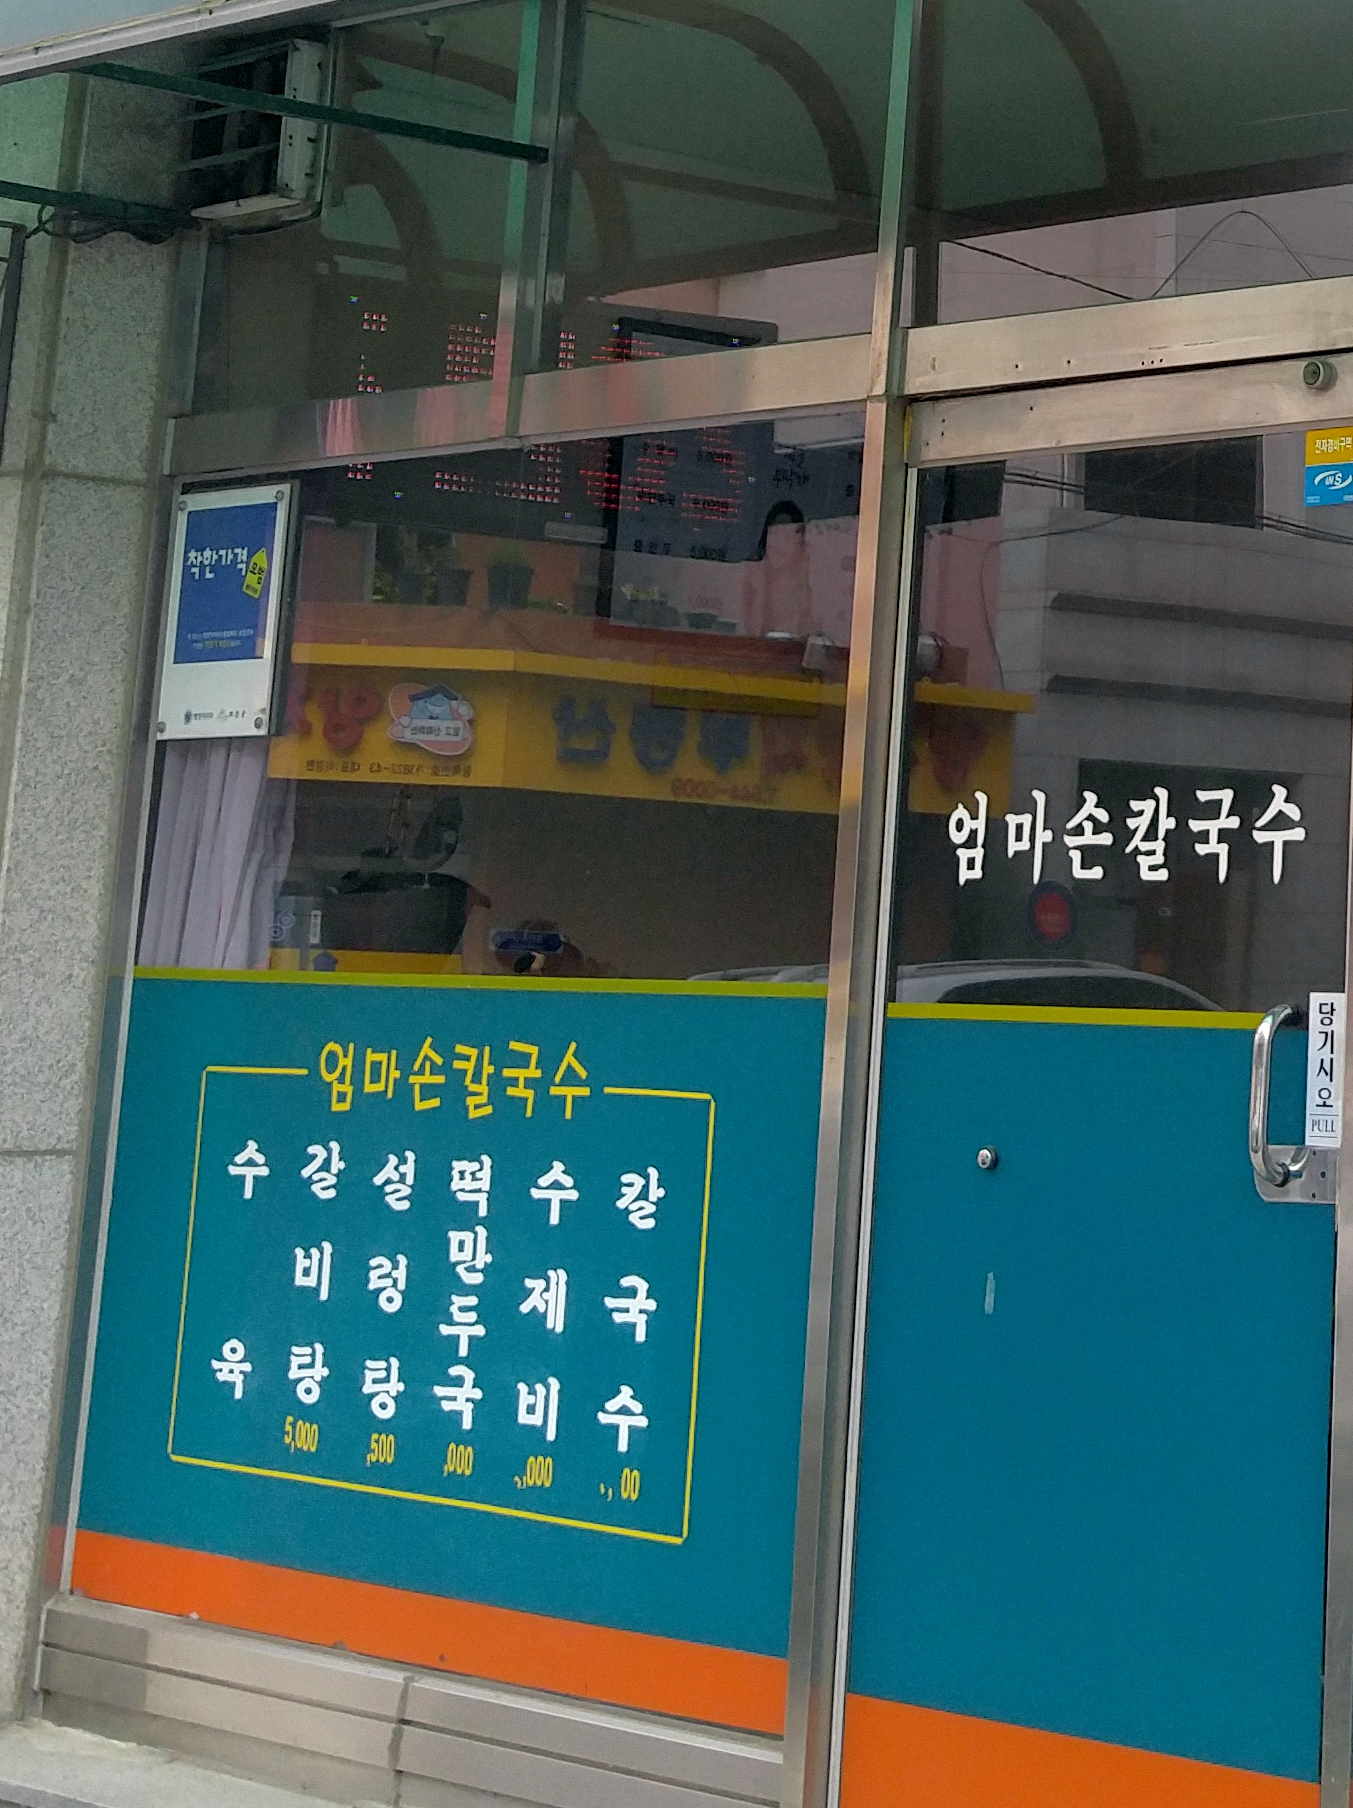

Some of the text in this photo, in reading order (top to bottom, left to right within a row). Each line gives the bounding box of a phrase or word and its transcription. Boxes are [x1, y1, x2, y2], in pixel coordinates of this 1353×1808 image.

[186, 546, 249, 580] 착한가격
[947, 783, 1307, 887] 엄마손칼국수
[319, 1036, 591, 1120] 엄마손칼국수
[1315, 1001, 1337, 1109] 당기시오
[1311, 1118, 1337, 1134] PULL
[286, 1139, 347, 1405] 갈비탕
[361, 1150, 417, 1421] 설렁탕
[433, 1154, 494, 1430] 떡만두국
[516, 1160, 580, 1442] 수제비
[597, 1166, 666, 1453] 칼국수
[283, 1415, 319, 1454] 5,000
